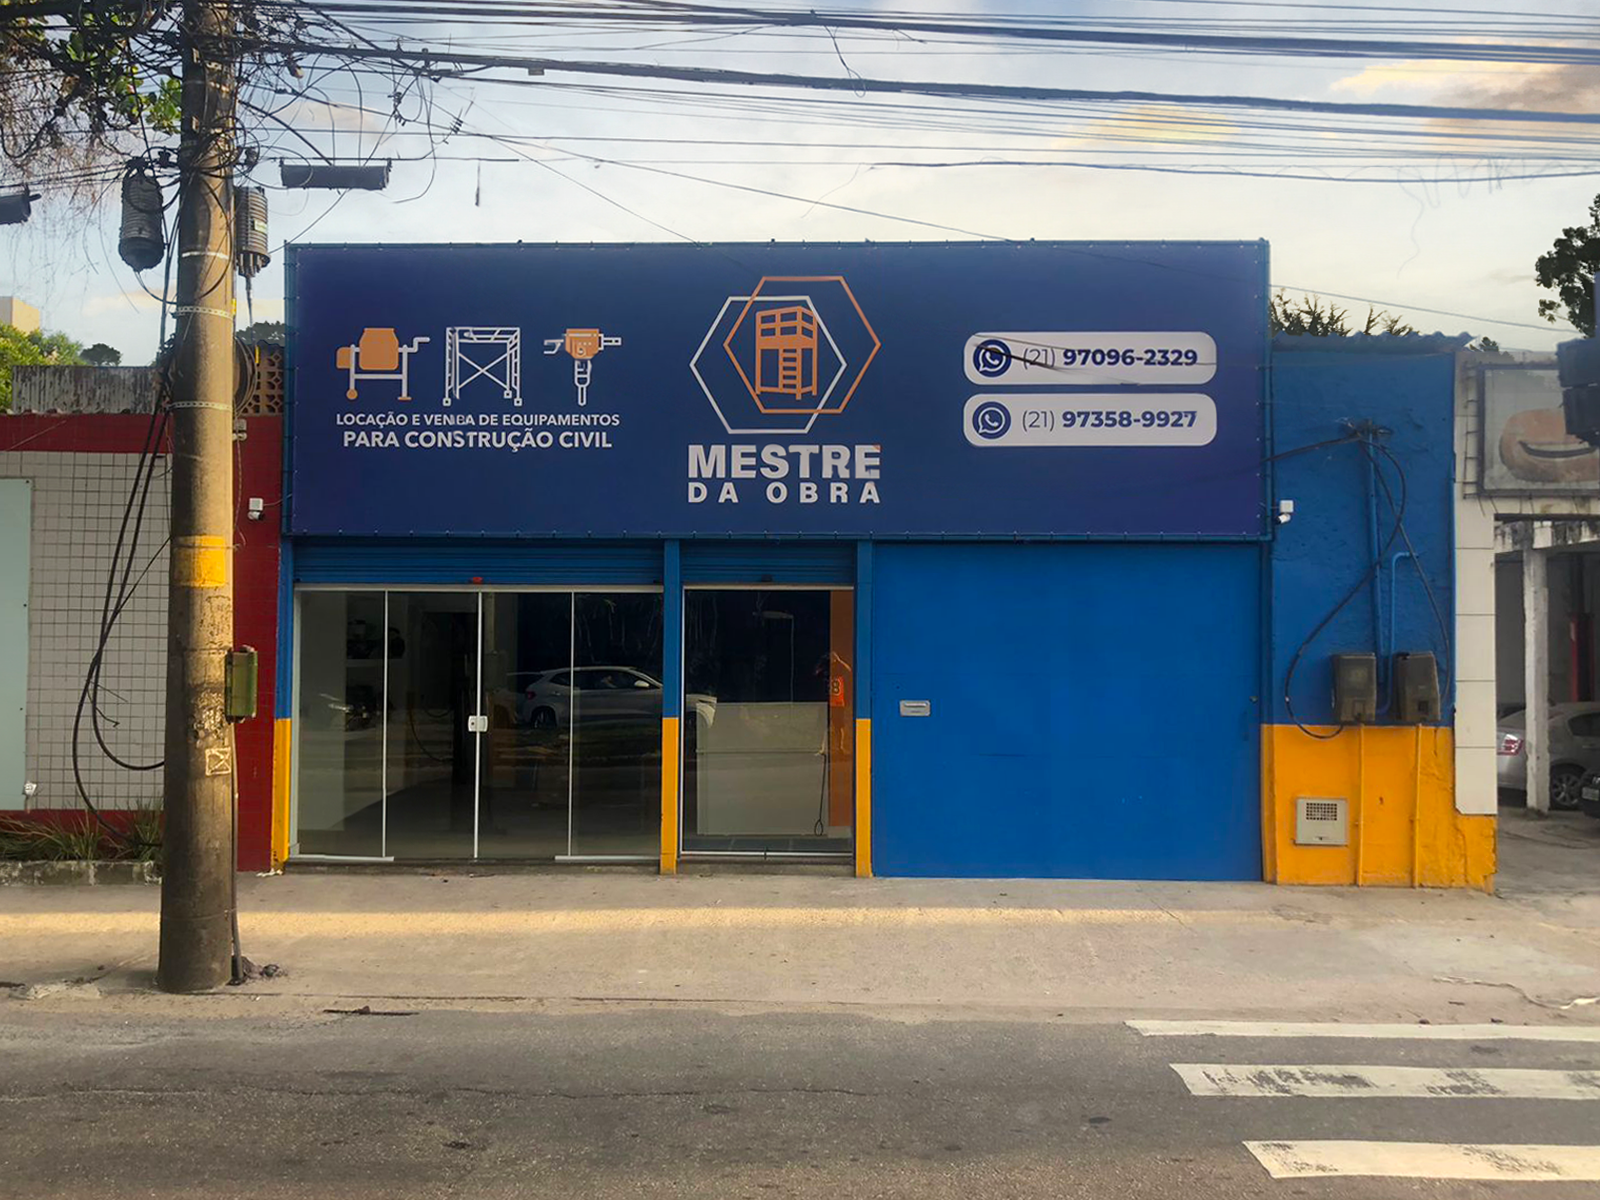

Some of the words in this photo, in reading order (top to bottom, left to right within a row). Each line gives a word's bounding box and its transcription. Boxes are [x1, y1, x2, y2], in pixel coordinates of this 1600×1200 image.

[1023, 348, 1055, 370] (21)
[1063, 349, 1198, 366] 97096-2329
[336, 411, 408, 429] LOCAÇÃO
[412, 414, 420, 426] E
[479, 414, 499, 426] DE
[502, 414, 620, 427] EQUIPAMENTOS
[1022, 410, 1055, 432] (21)
[1062, 411, 1198, 428] 97358-9927
[343, 431, 400, 448] PARA
[404, 427, 553, 453] CONSTRUÇÃO
[559, 431, 613, 448] CIVIL
[688, 444, 881, 479] MESTRE
[688, 482, 739, 503] DA
[766, 481, 881, 503] OBRA
